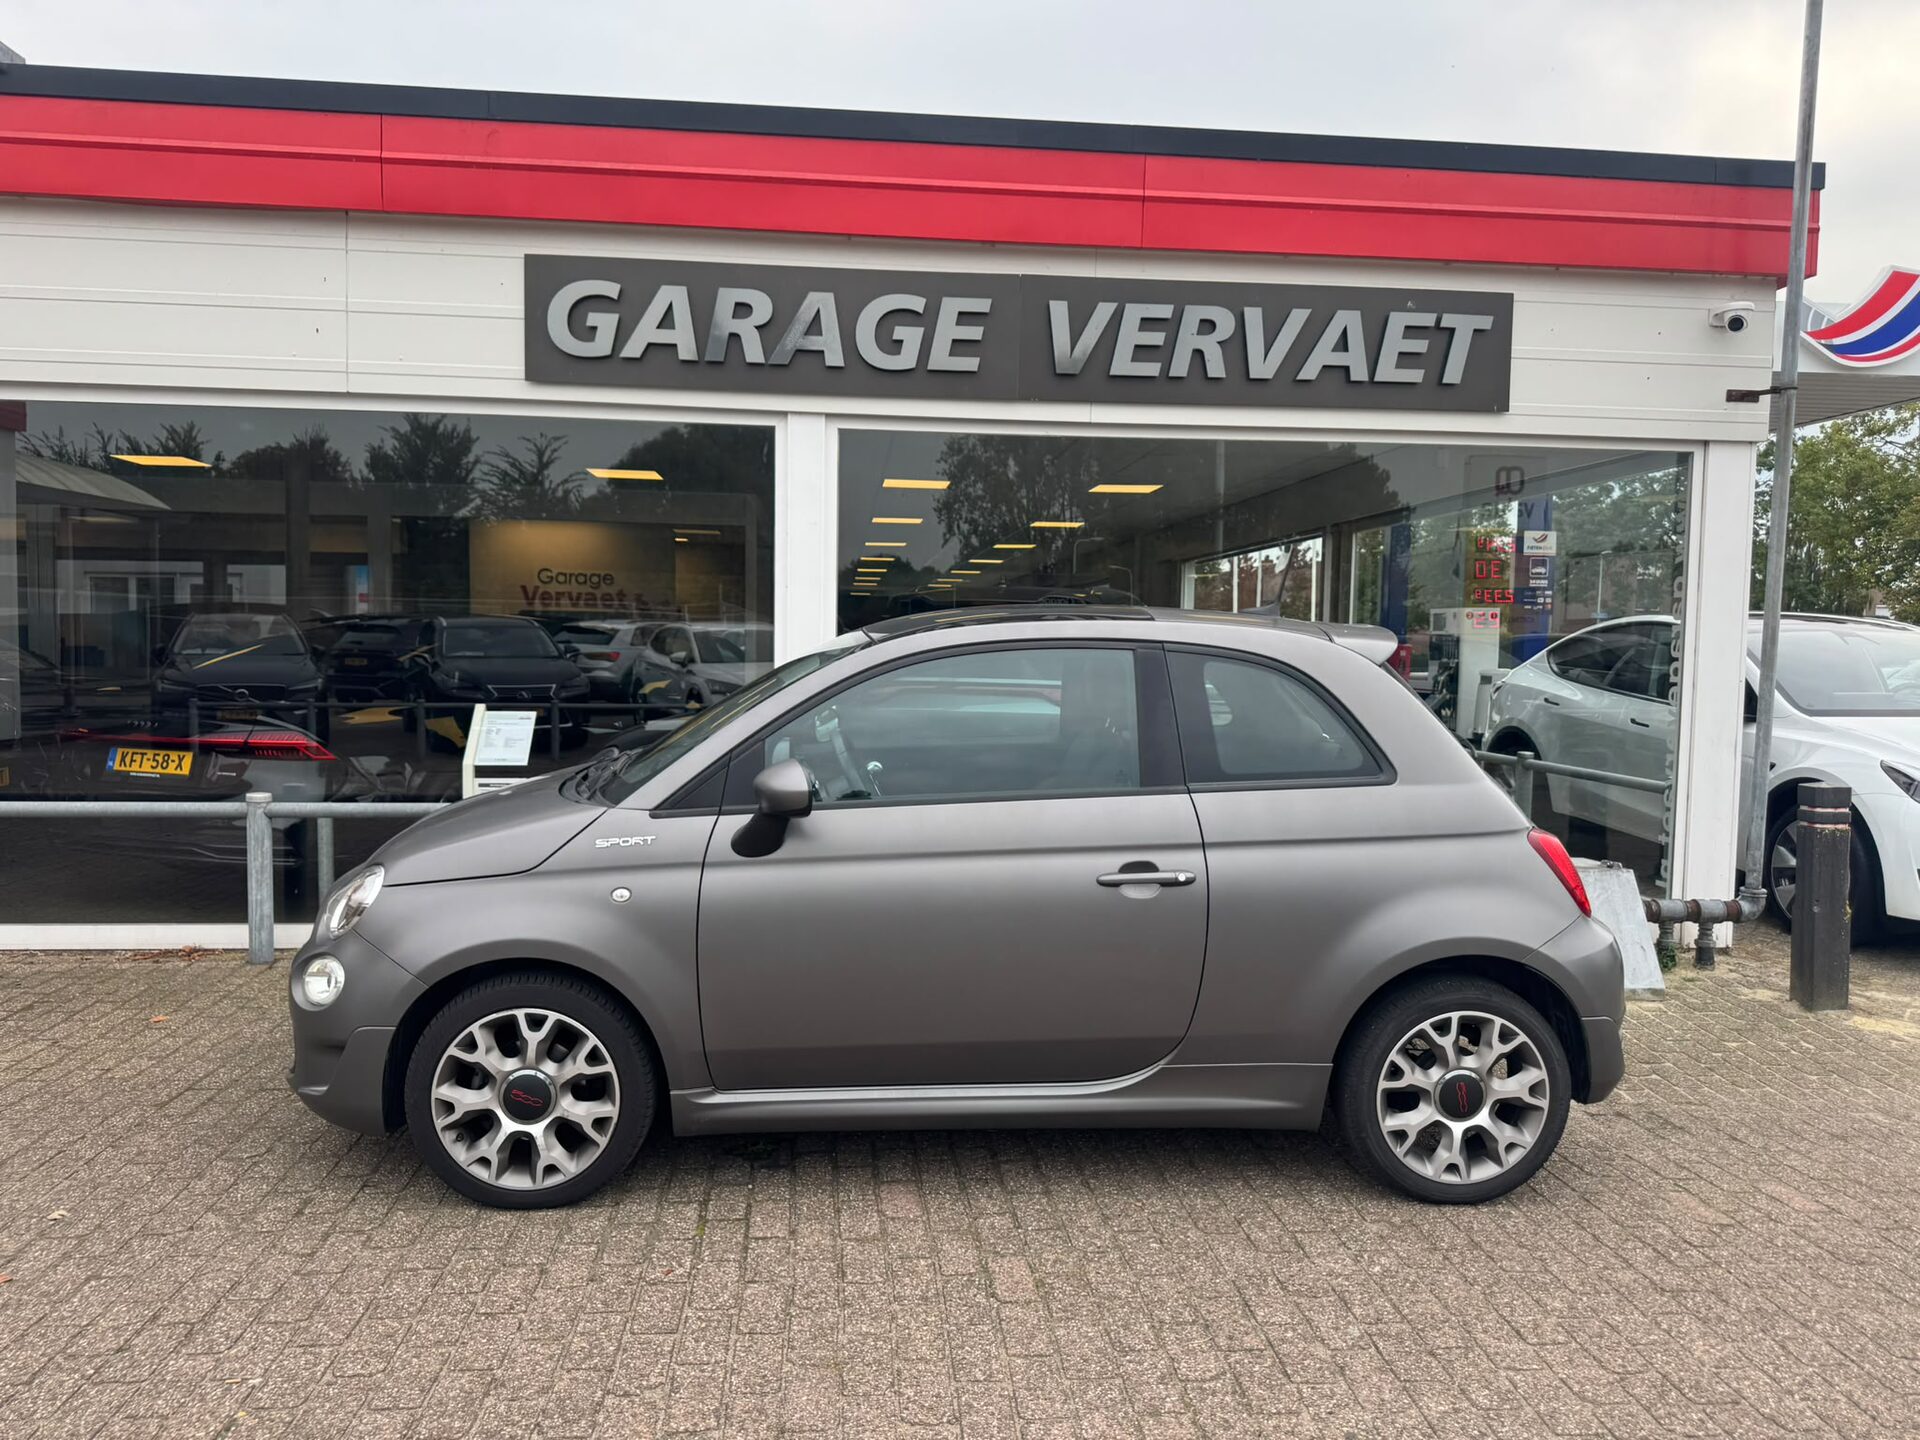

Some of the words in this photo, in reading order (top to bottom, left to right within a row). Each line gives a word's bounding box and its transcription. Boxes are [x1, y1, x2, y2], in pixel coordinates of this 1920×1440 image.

[547, 279, 992, 373] GARAGE
[1048, 300, 1495, 385] VERVAET
[537, 568, 615, 590] Garage
[520, 585, 627, 608] Vervaet
[119, 751, 186, 771] KFT-58-X
[595, 836, 656, 848] SPORT
